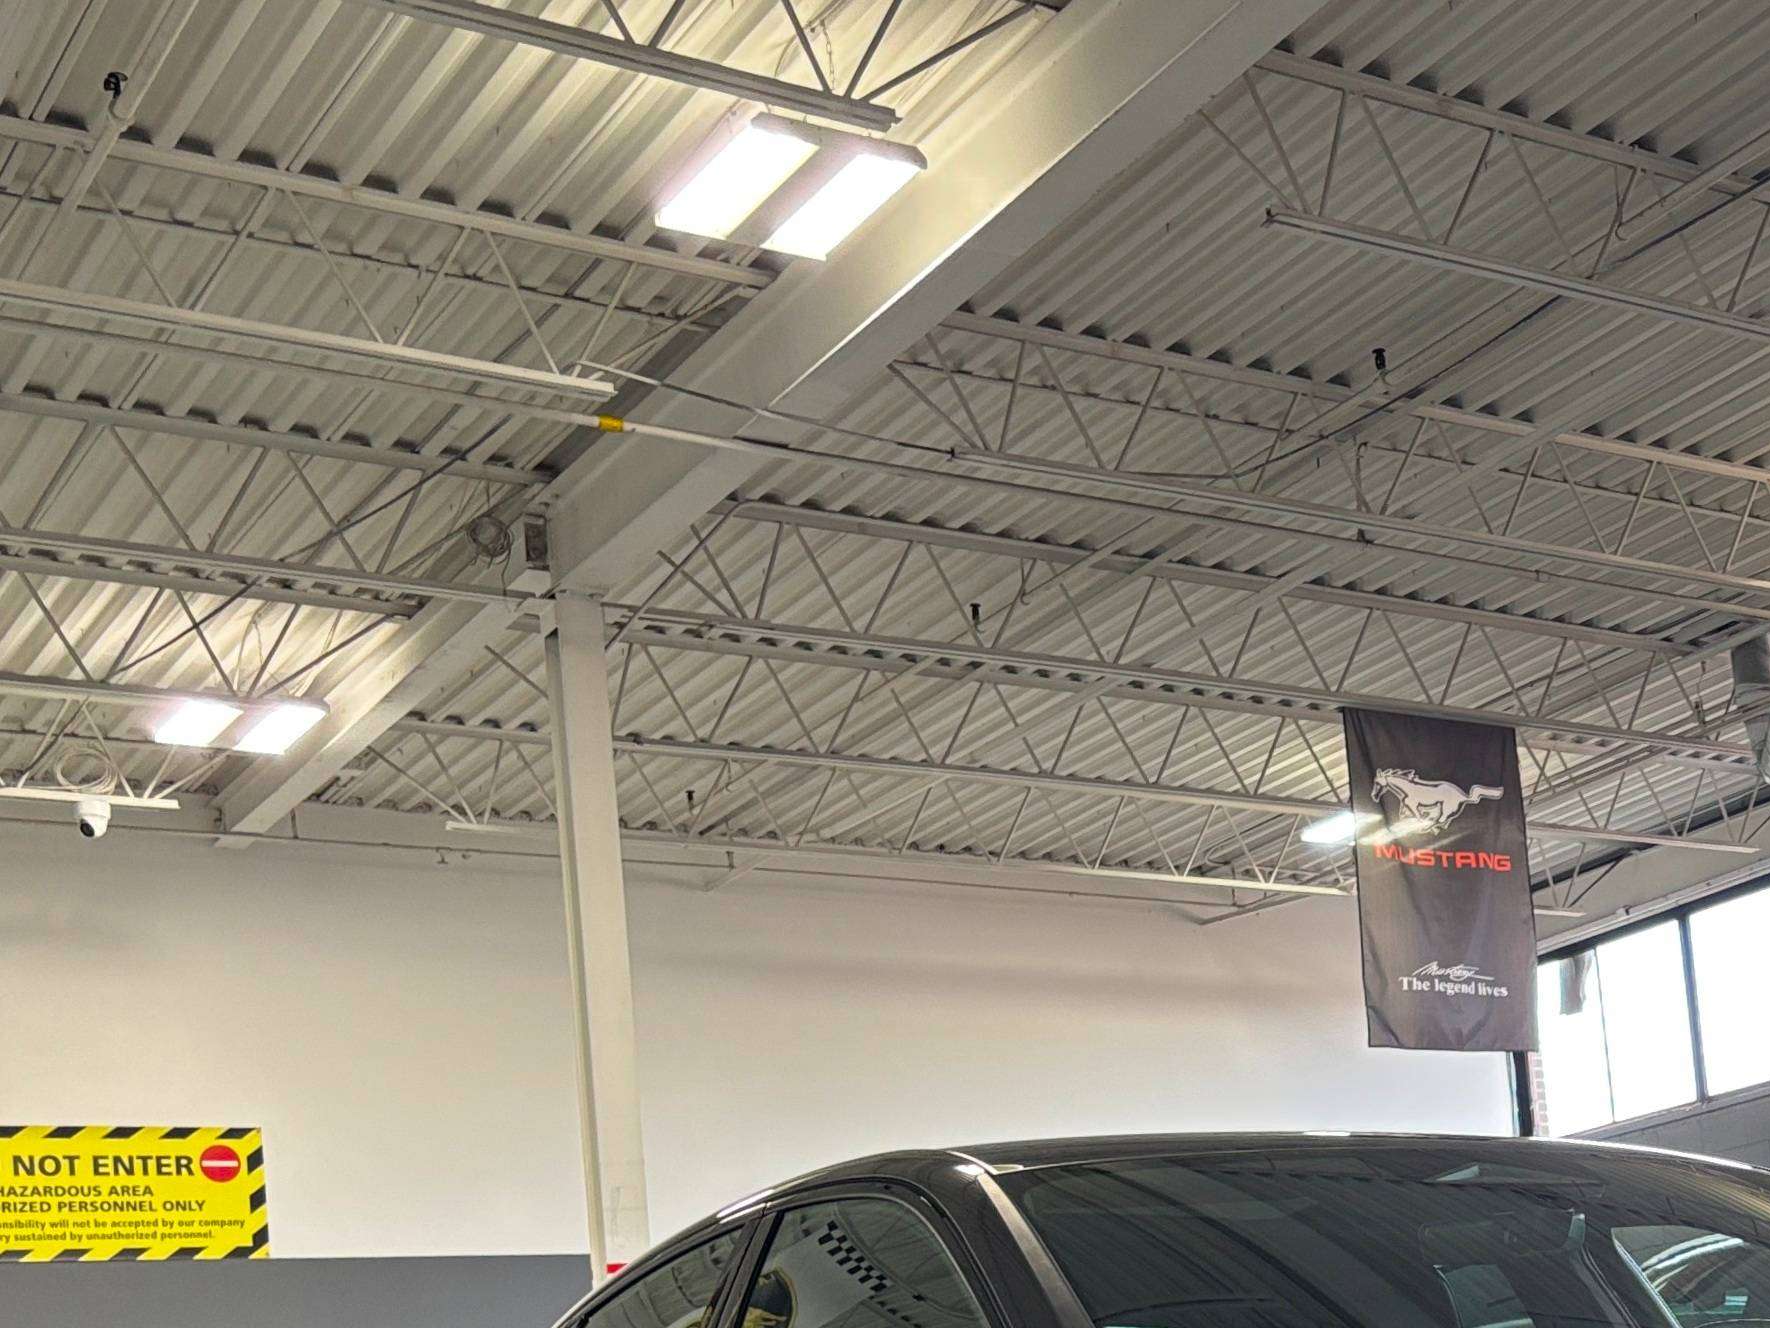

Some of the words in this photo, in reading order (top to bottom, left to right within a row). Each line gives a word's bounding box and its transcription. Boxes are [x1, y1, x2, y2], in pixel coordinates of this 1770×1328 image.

[1374, 843, 1511, 872] MUSTANG
[1399, 976, 1431, 992] The
[1434, 978, 1475, 996] legend
[1477, 981, 1509, 997] lives
[12, 1154, 80, 1177] NOT
[92, 1154, 195, 1177] ENTER
[108, 1185, 154, 1197] AREA
[57, 1200, 157, 1212] PERSONNEL
[162, 1200, 206, 1212] ONLY
[49, 1219, 69, 1229] will
[72, 1220, 91, 1229] not
[94, 1218, 108, 1229] be
[110, 1218, 159, 1229] accepted
[161, 1217, 175, 1229] by
[177, 1220, 195, 1228] our
[198, 1219, 246, 1229] company
[14, 1231, 67, 1241] sustained
[70, 1232, 83, 1242] by
[86, 1230, 158, 1241] unauthorized
